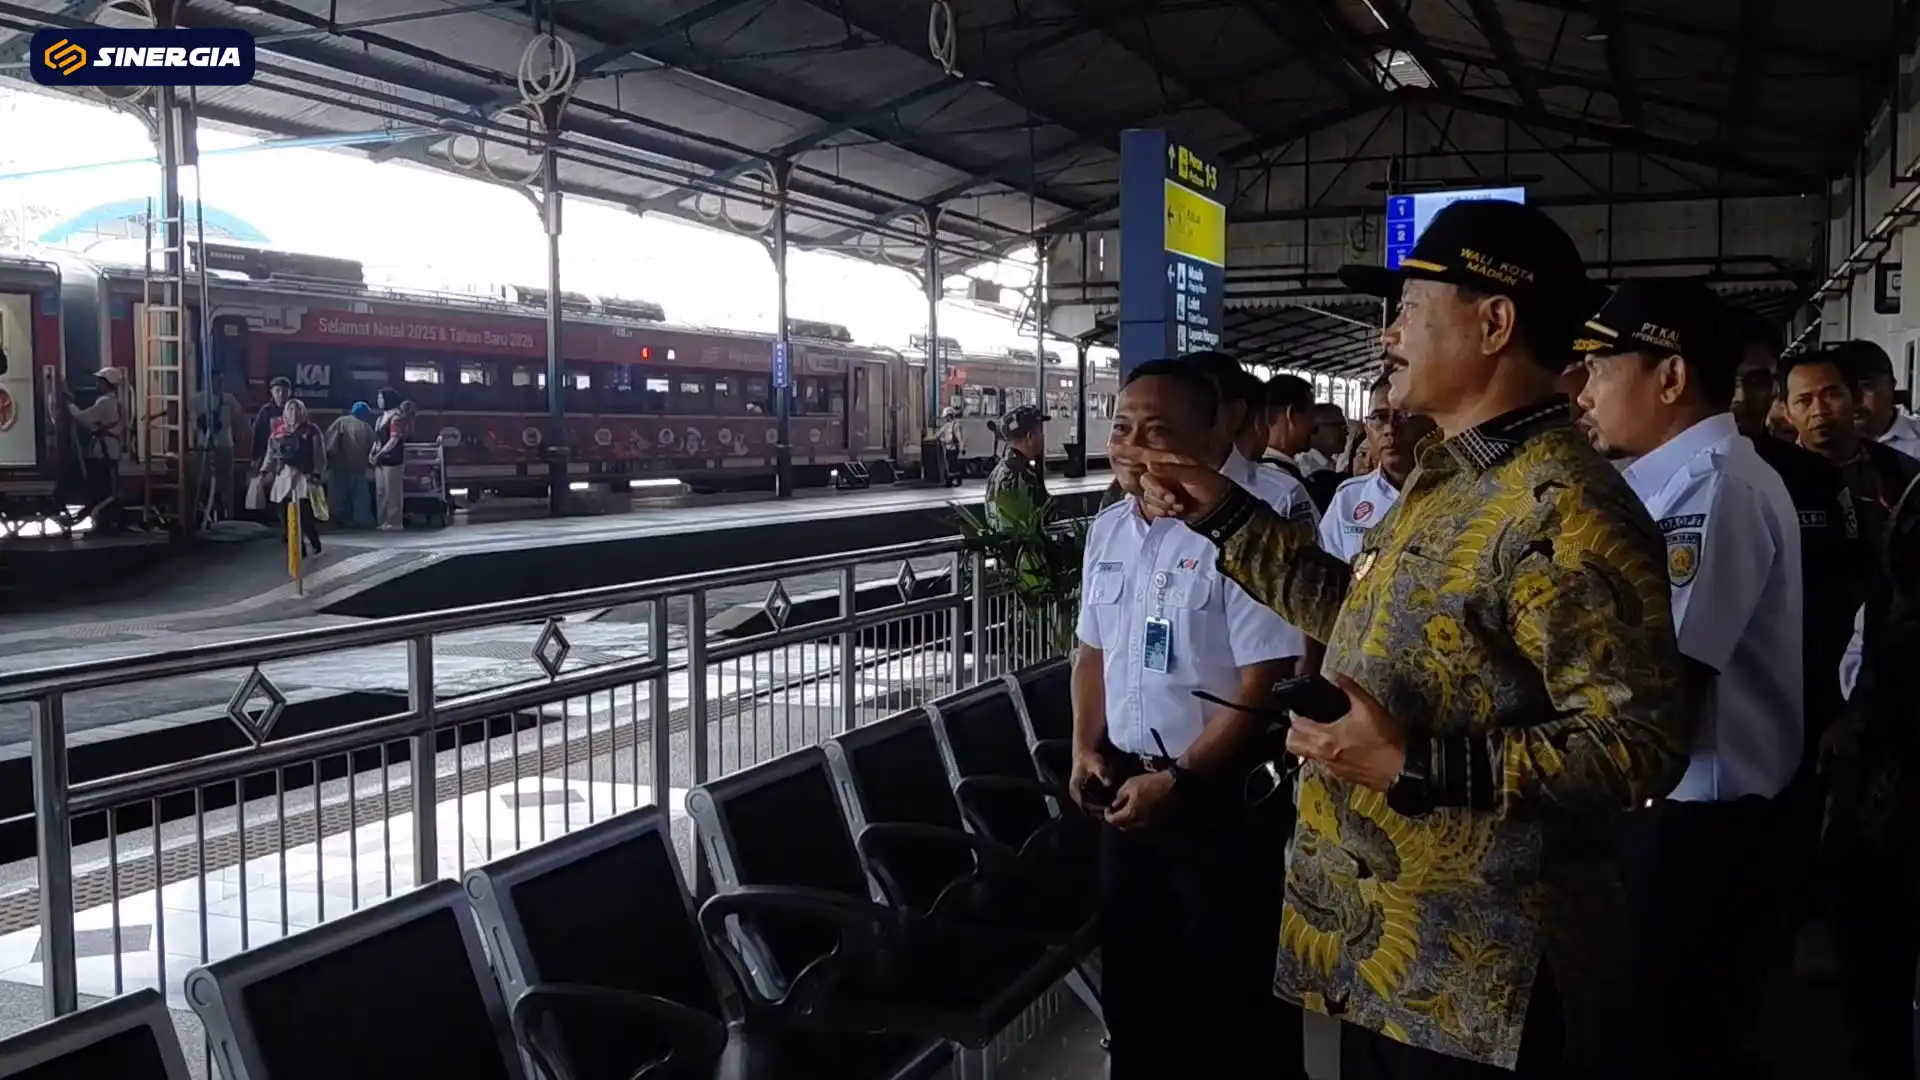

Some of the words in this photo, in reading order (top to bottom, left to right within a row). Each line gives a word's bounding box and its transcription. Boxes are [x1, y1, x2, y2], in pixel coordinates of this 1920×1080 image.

[1460, 248, 1494, 265] WALI
[1500, 263, 1534, 282] KOTA
[1466, 261, 1518, 286] MADIUN
[319, 317, 370, 336] Selamat
[373, 321, 404, 338] Natal
[408, 324, 436, 341] 2025
[450, 328, 482, 344] Tahun
[484, 331, 508, 346] Baru
[510, 333, 534, 348] 2026
[1641, 322, 1659, 335] PT
[1659, 328, 1681, 342] KAI
[296, 362, 331, 386] KAI
